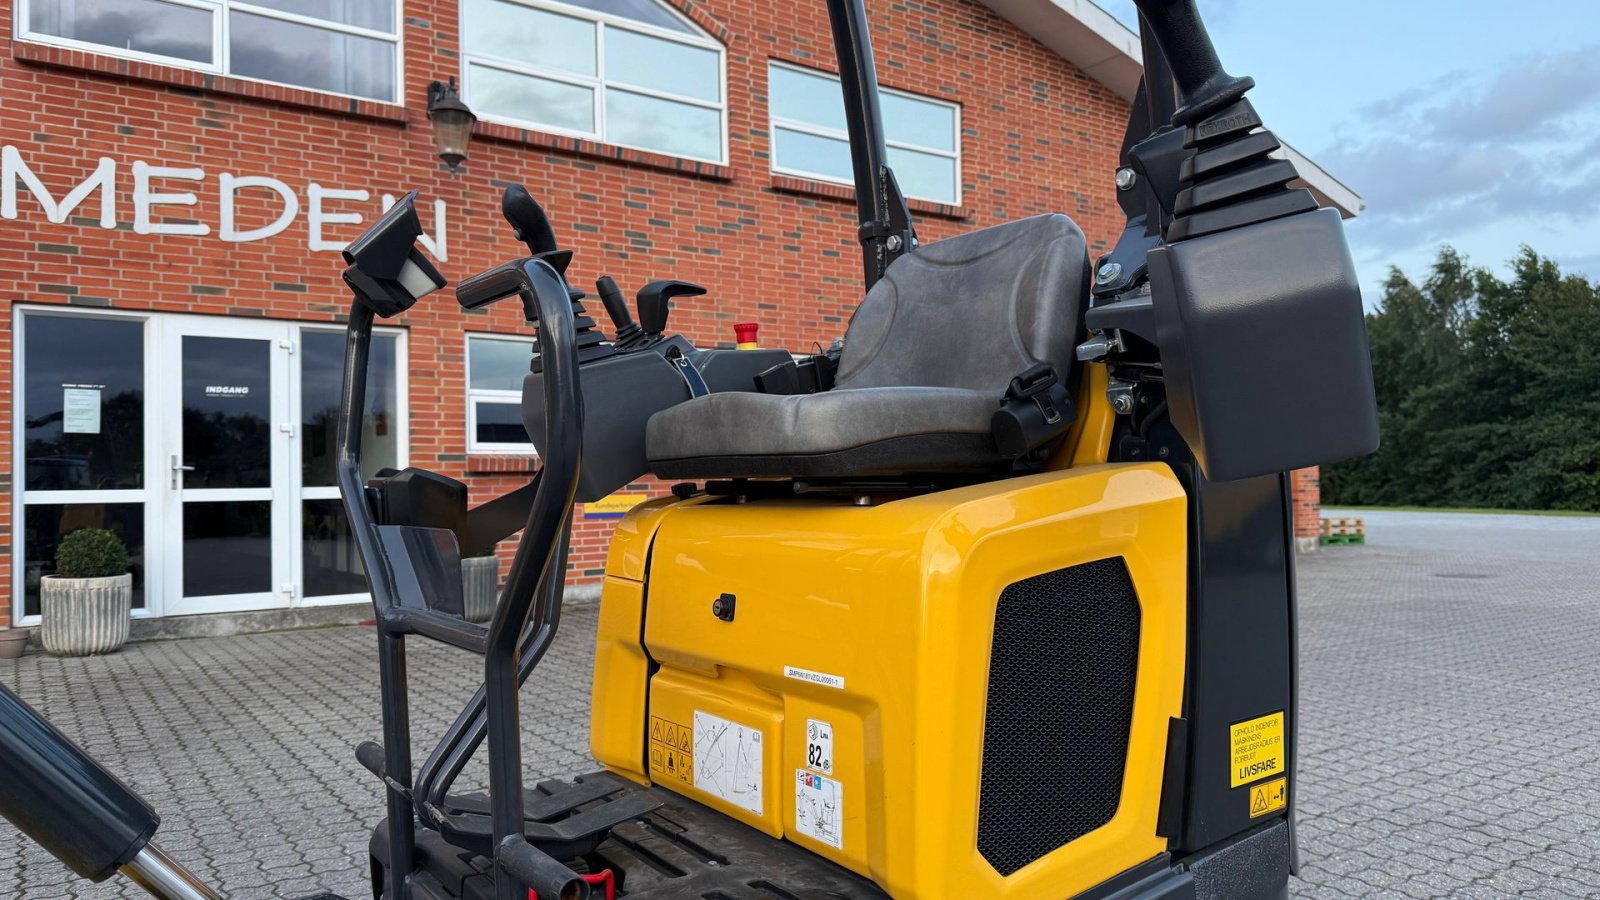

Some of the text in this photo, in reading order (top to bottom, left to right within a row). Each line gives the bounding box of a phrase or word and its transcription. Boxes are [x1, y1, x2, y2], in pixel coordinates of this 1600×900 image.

[205, 386, 249, 394] INDGANG
[1234, 718, 1279, 737] OPHOLD INDENFOR
[1234, 732, 1262, 746] MASKINENS
[1234, 735, 1281, 756] ARBEJDSRADIUS ER
[808, 743, 822, 767] 82
[1234, 751, 1257, 765] FORBUDT
[1239, 757, 1277, 779] LIVSFARE
